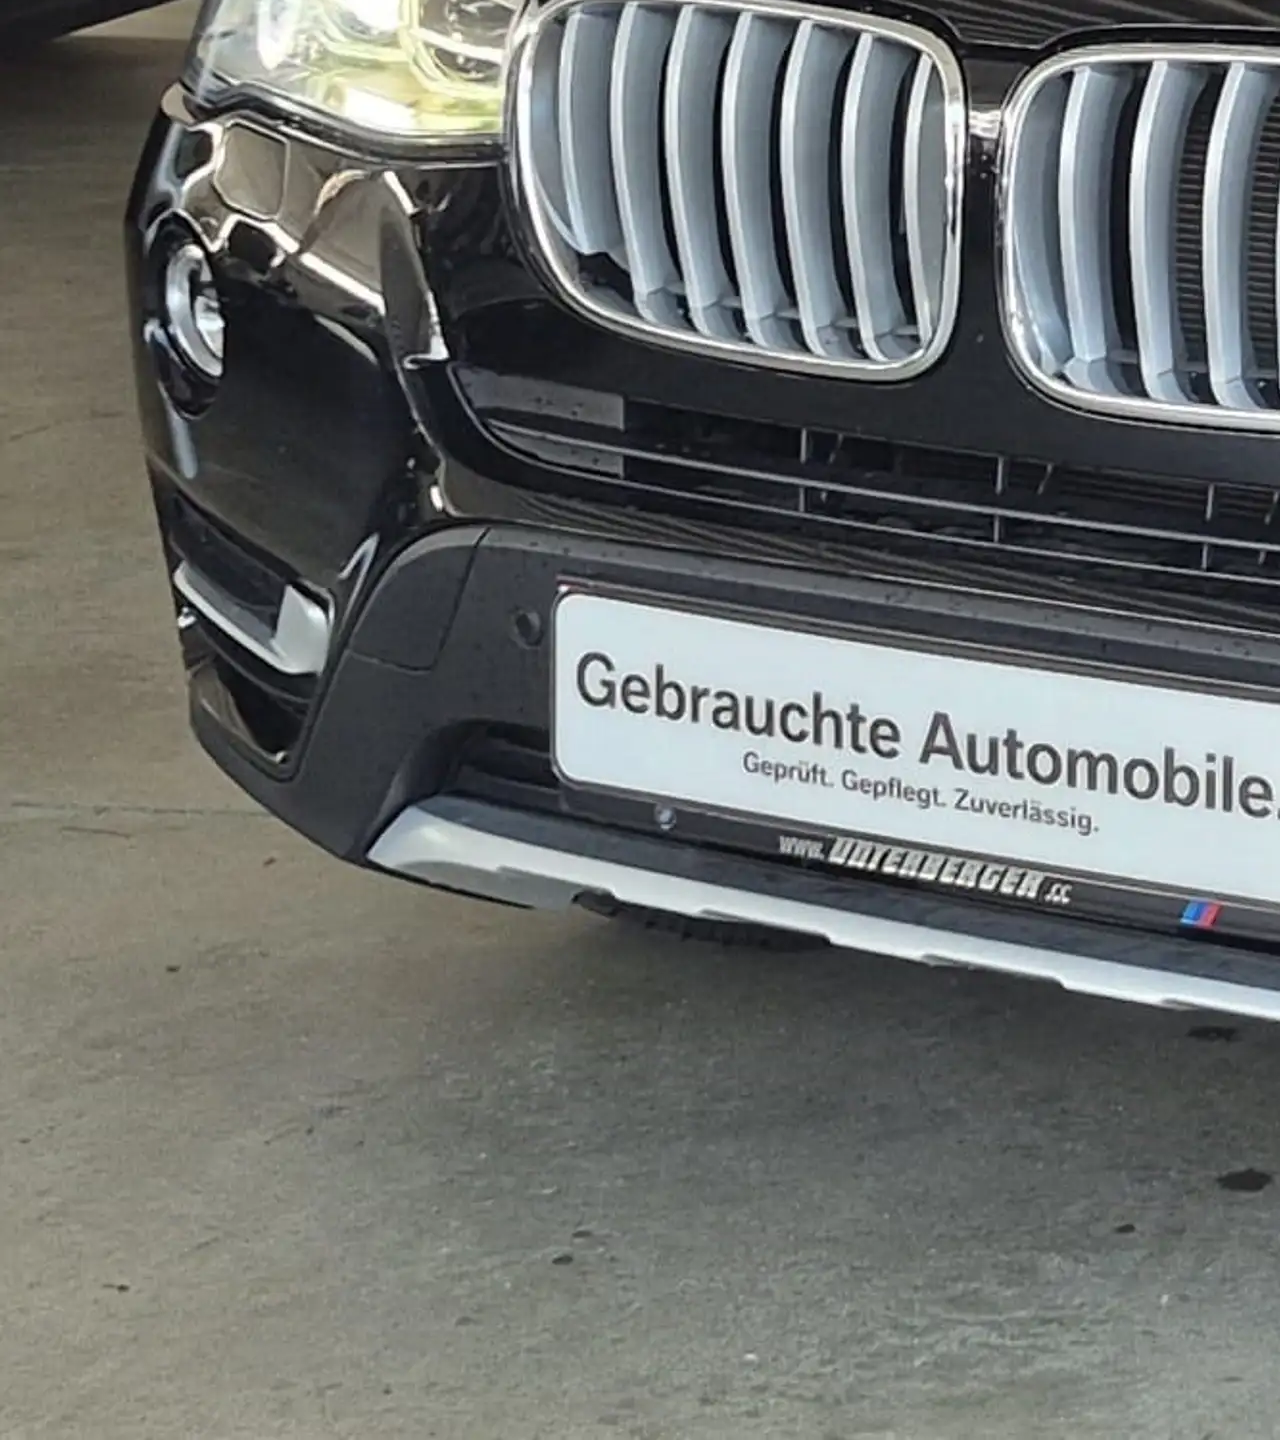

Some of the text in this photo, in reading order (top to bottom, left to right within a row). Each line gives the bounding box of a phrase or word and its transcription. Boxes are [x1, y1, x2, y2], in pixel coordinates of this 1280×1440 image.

[576, 651, 901, 759] Gebrauchte
[743, 751, 1101, 836] Geprüft. Gepflegt. Zuverlässig.
